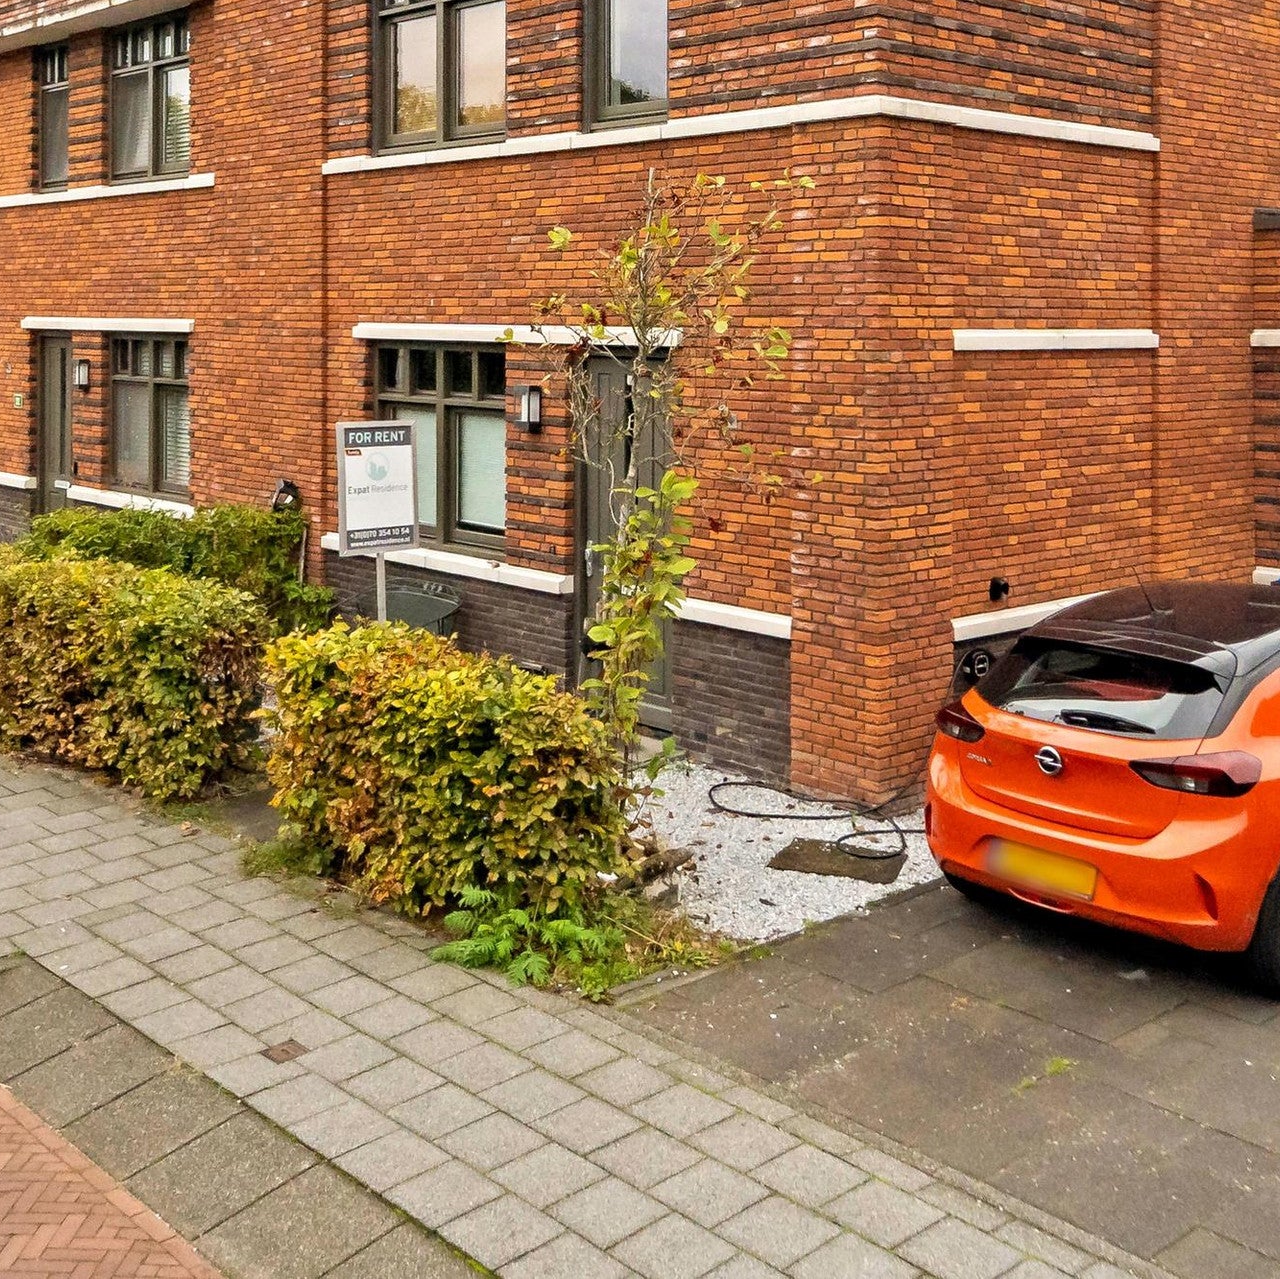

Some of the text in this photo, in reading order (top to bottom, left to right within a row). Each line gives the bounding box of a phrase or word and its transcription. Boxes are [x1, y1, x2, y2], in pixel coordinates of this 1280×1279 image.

[349, 430, 405, 444] FOR RENT
[348, 483, 408, 495] Expat Residence
